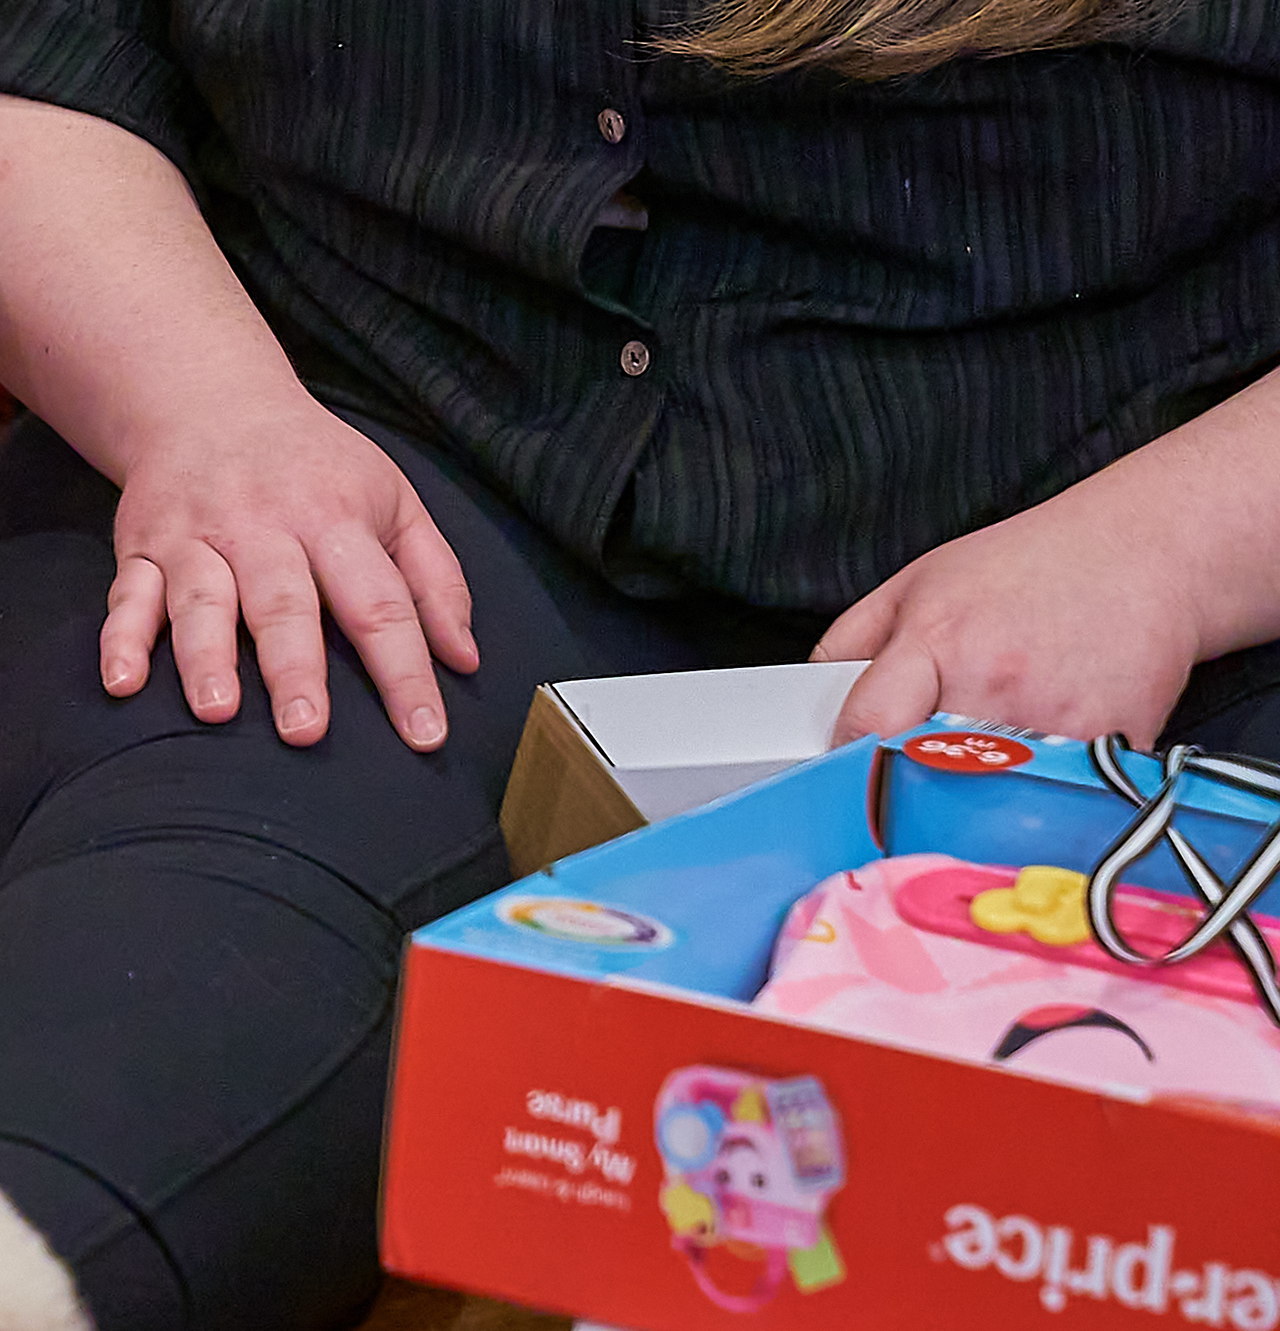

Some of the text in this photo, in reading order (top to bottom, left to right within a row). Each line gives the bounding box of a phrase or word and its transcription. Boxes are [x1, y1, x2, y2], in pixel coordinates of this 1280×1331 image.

[526, 1090, 622, 1147] Purse
[587, 1142, 637, 1186] My
[942, 1202, 1280, 1331] er-price
